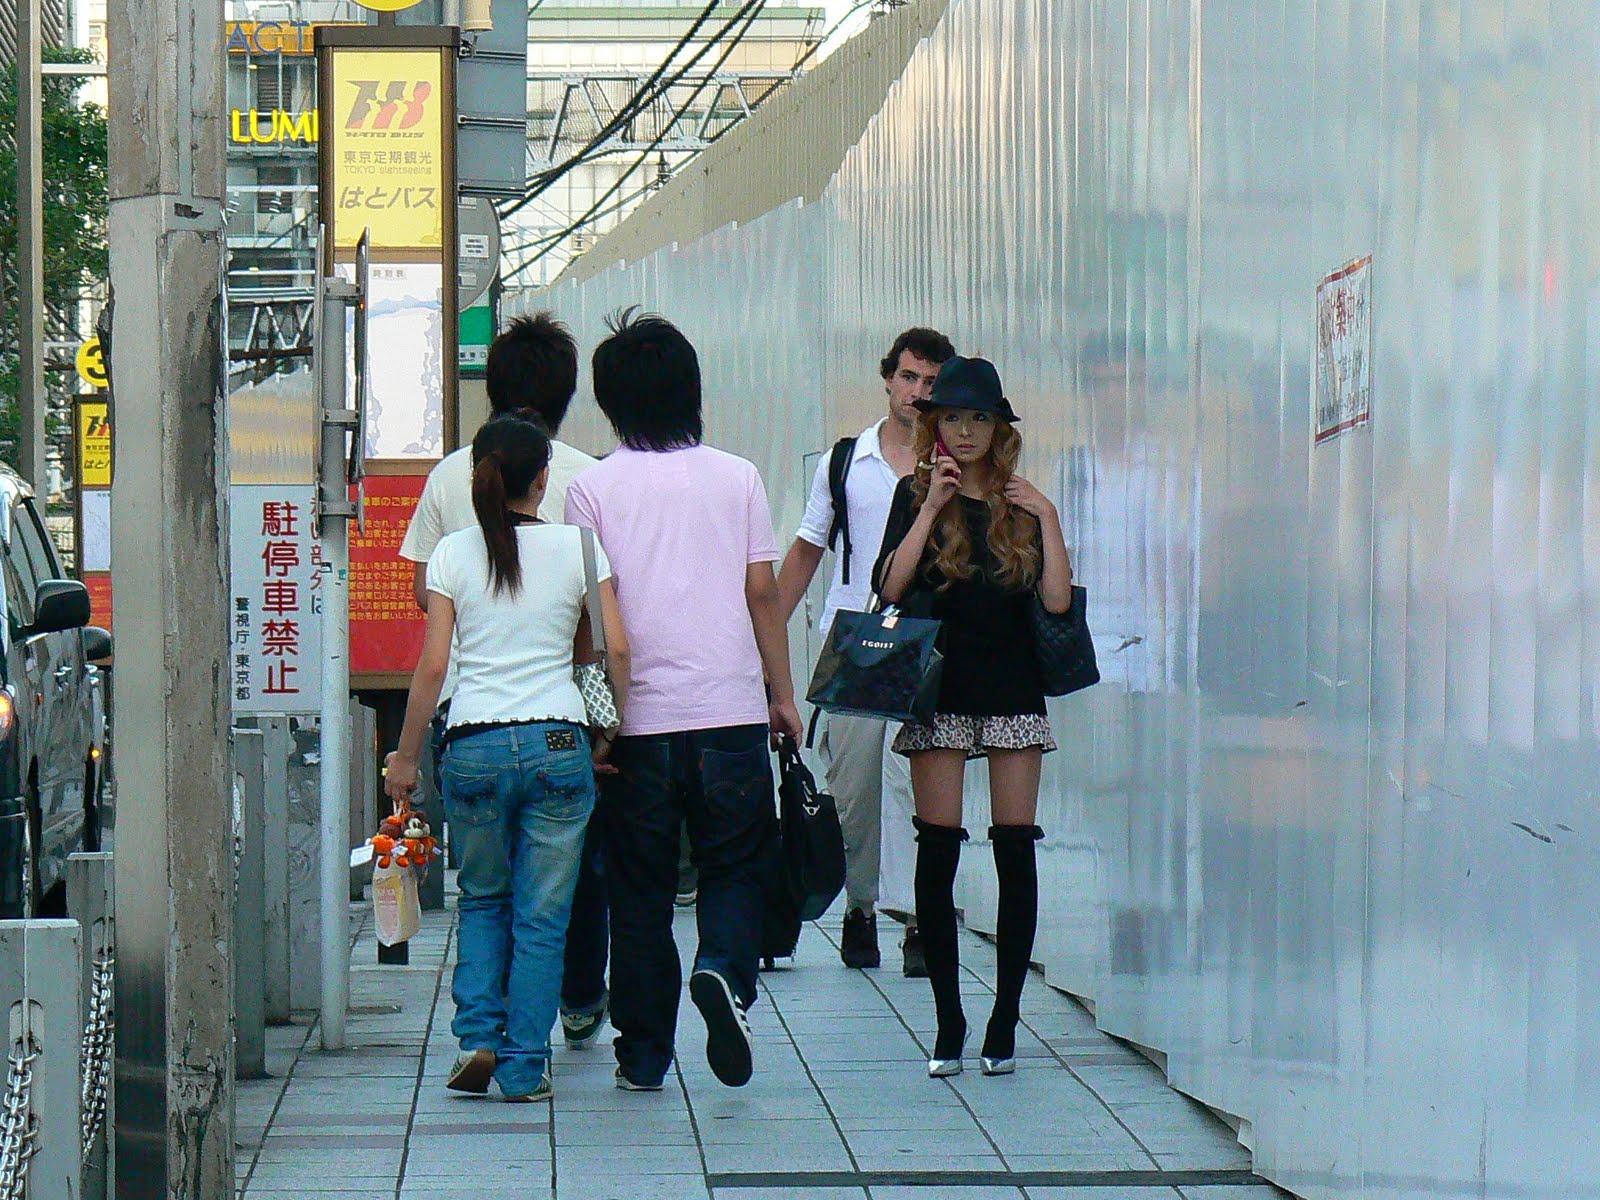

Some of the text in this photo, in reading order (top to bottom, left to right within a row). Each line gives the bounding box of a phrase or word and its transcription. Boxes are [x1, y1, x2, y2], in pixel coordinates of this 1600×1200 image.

[344, 151, 432, 164] 東京定期観光
[344, 165, 432, 175] TOKYO sightseeing
[339, 186, 436, 209] はとバス
[261, 500, 300, 694] 駐停車禁止
[861, 640, 895, 649] EGOIST
